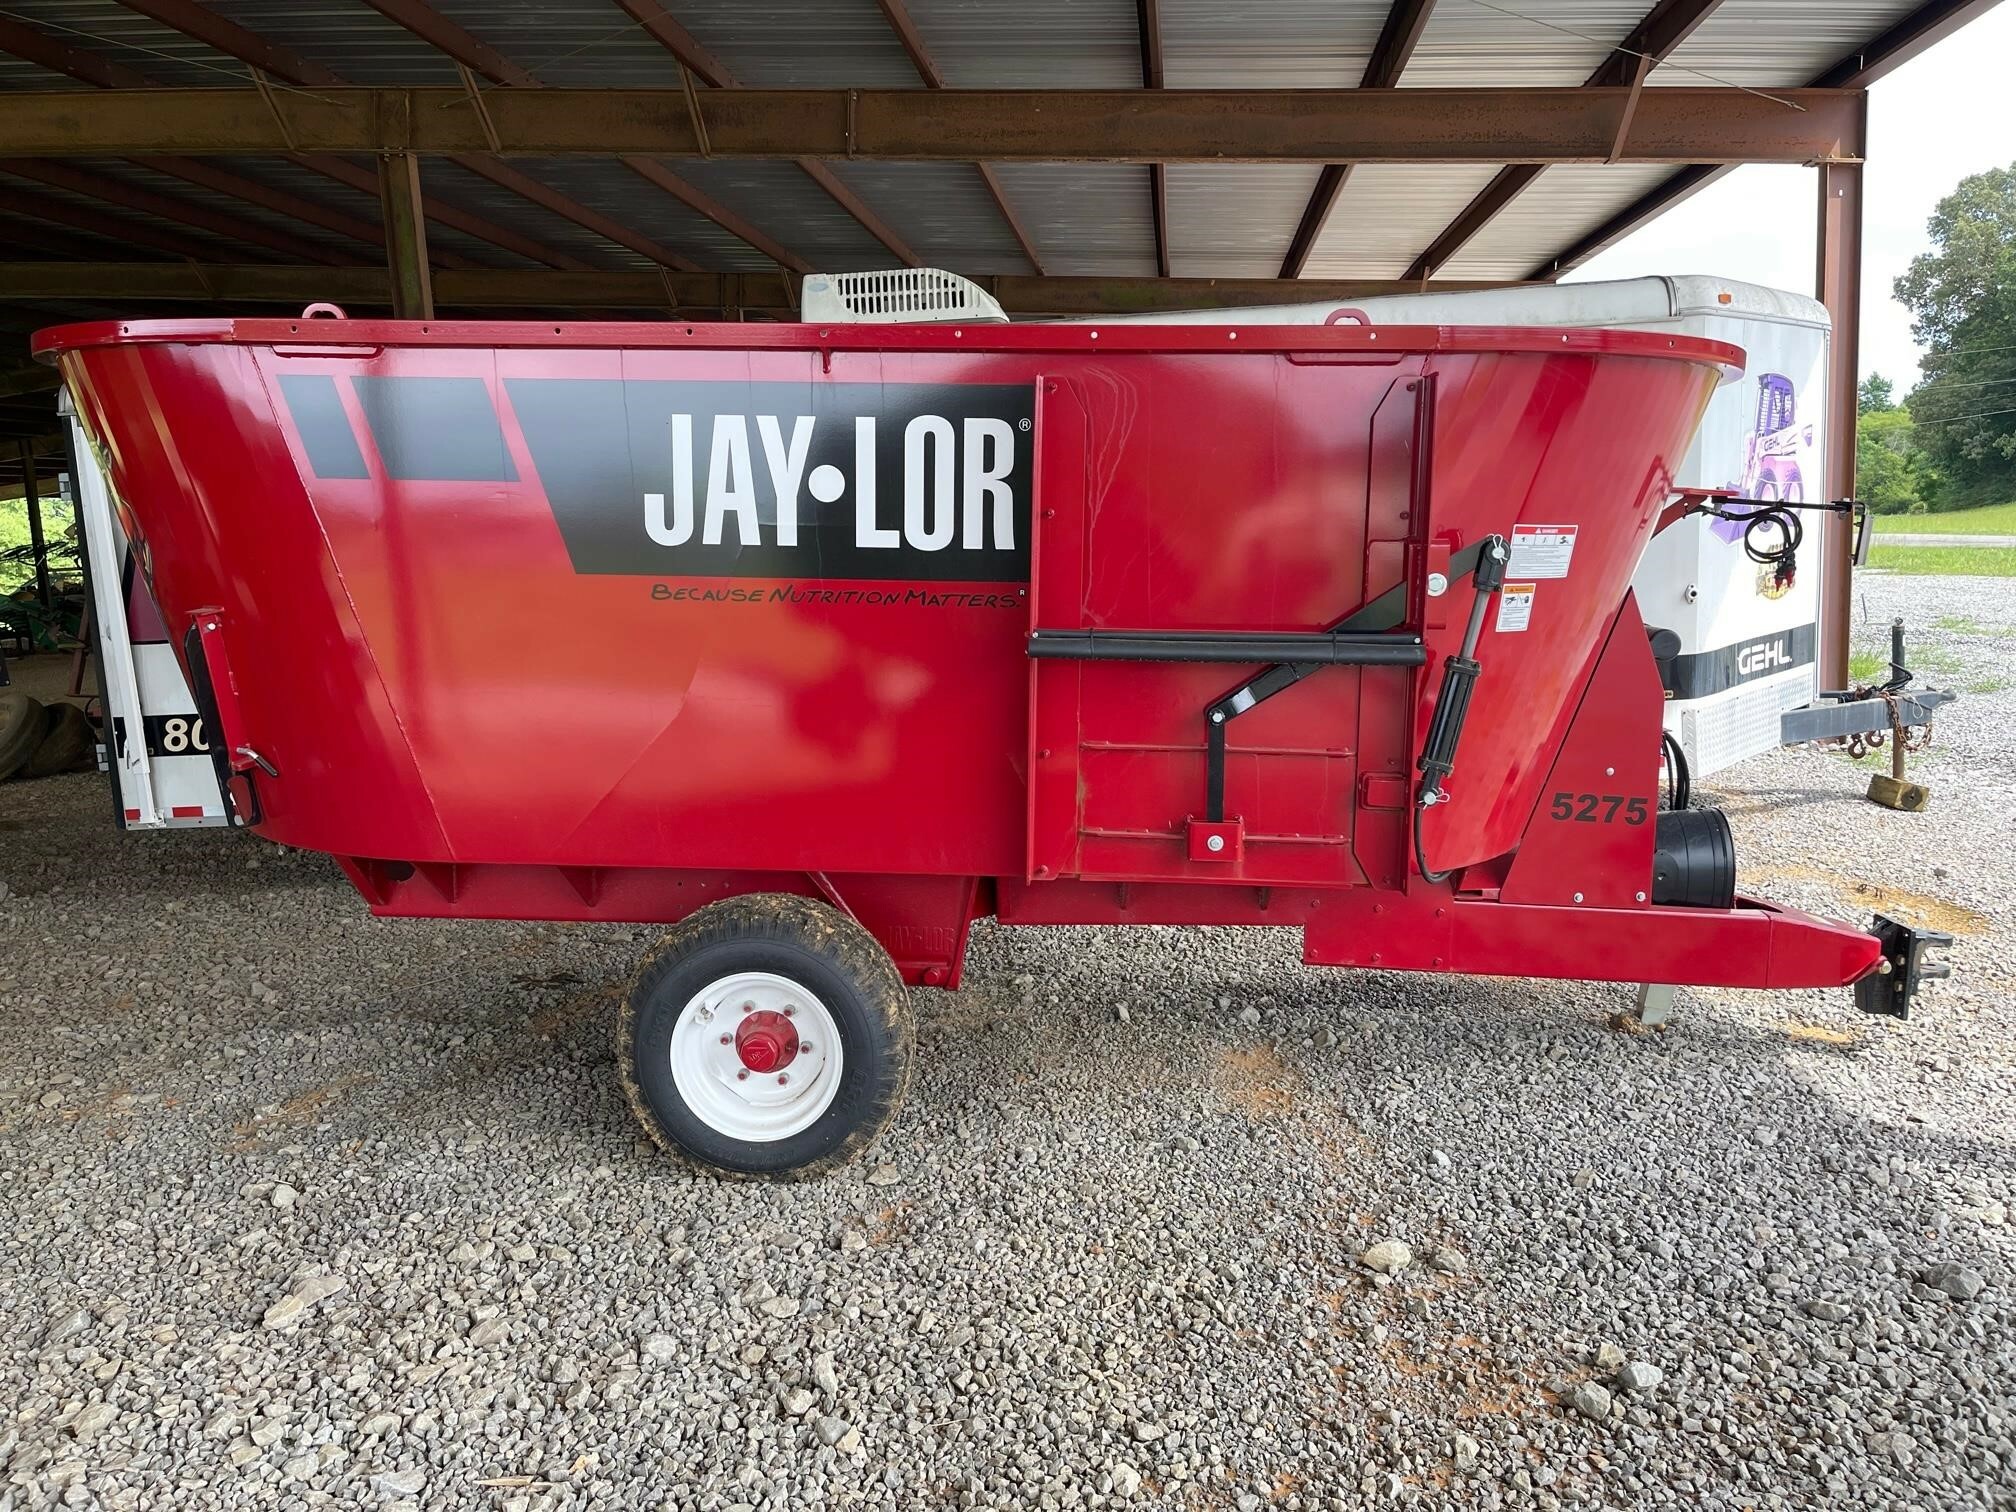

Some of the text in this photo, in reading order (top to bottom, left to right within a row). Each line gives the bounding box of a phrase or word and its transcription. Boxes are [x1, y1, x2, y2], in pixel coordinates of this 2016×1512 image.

[651, 583, 764, 602] BECAUSE
[769, 584, 900, 603] NUTRITION
[1551, 792, 1648, 825] 5275
